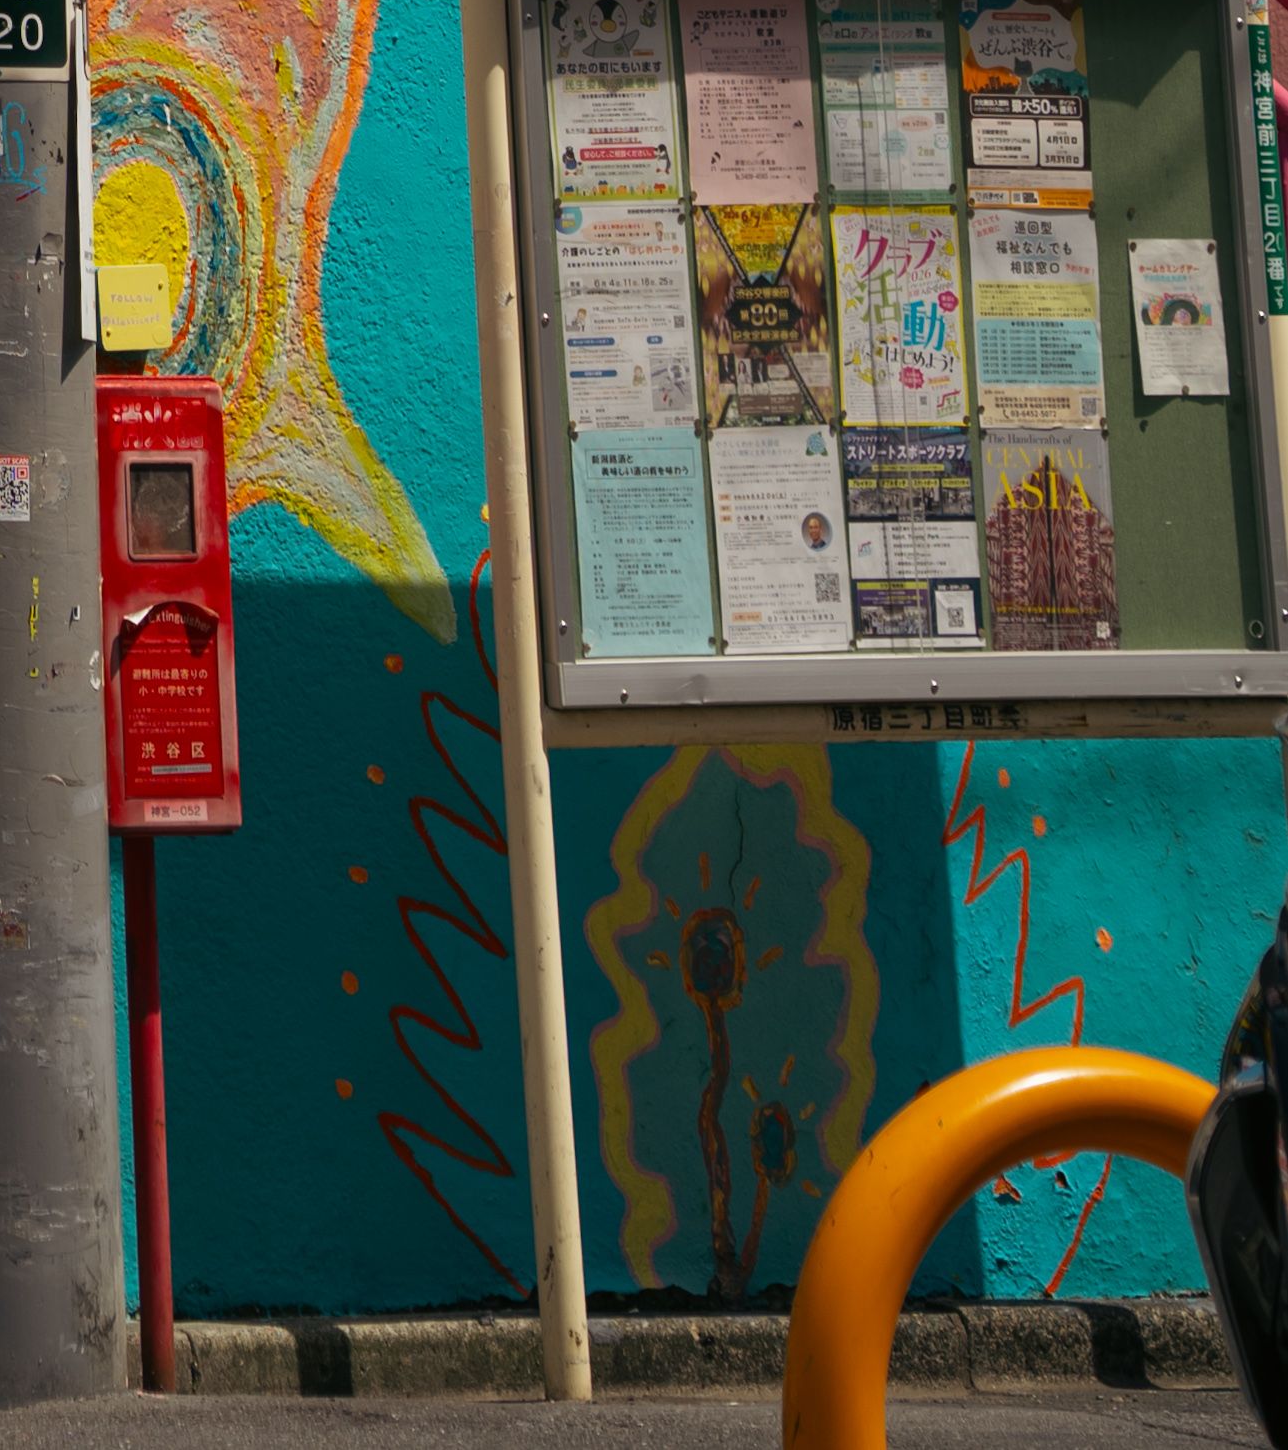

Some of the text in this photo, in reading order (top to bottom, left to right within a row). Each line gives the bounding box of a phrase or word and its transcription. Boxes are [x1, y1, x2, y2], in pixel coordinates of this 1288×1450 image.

[555, 60, 662, 75] あなたの町にもいます
[1014, 220, 1053, 235] 巡回型
[854, 228, 943, 280] クラブ
[996, 240, 1073, 255] 福祉なんでも
[1010, 260, 1061, 275] 相談窓口
[1138, 263, 1200, 275] ホームカミングデー
[987, 433, 1006, 445] The
[1008, 433, 1059, 446] Handicrafts
[846, 443, 967, 462] ストリートスポーツクラブ
[994, 470, 1098, 511] ASIA
[132, 667, 209, 683] 避難所は最寄りの
[138, 684, 205, 698] 小・中学校です
[141, 741, 206, 760] 渋谷区
